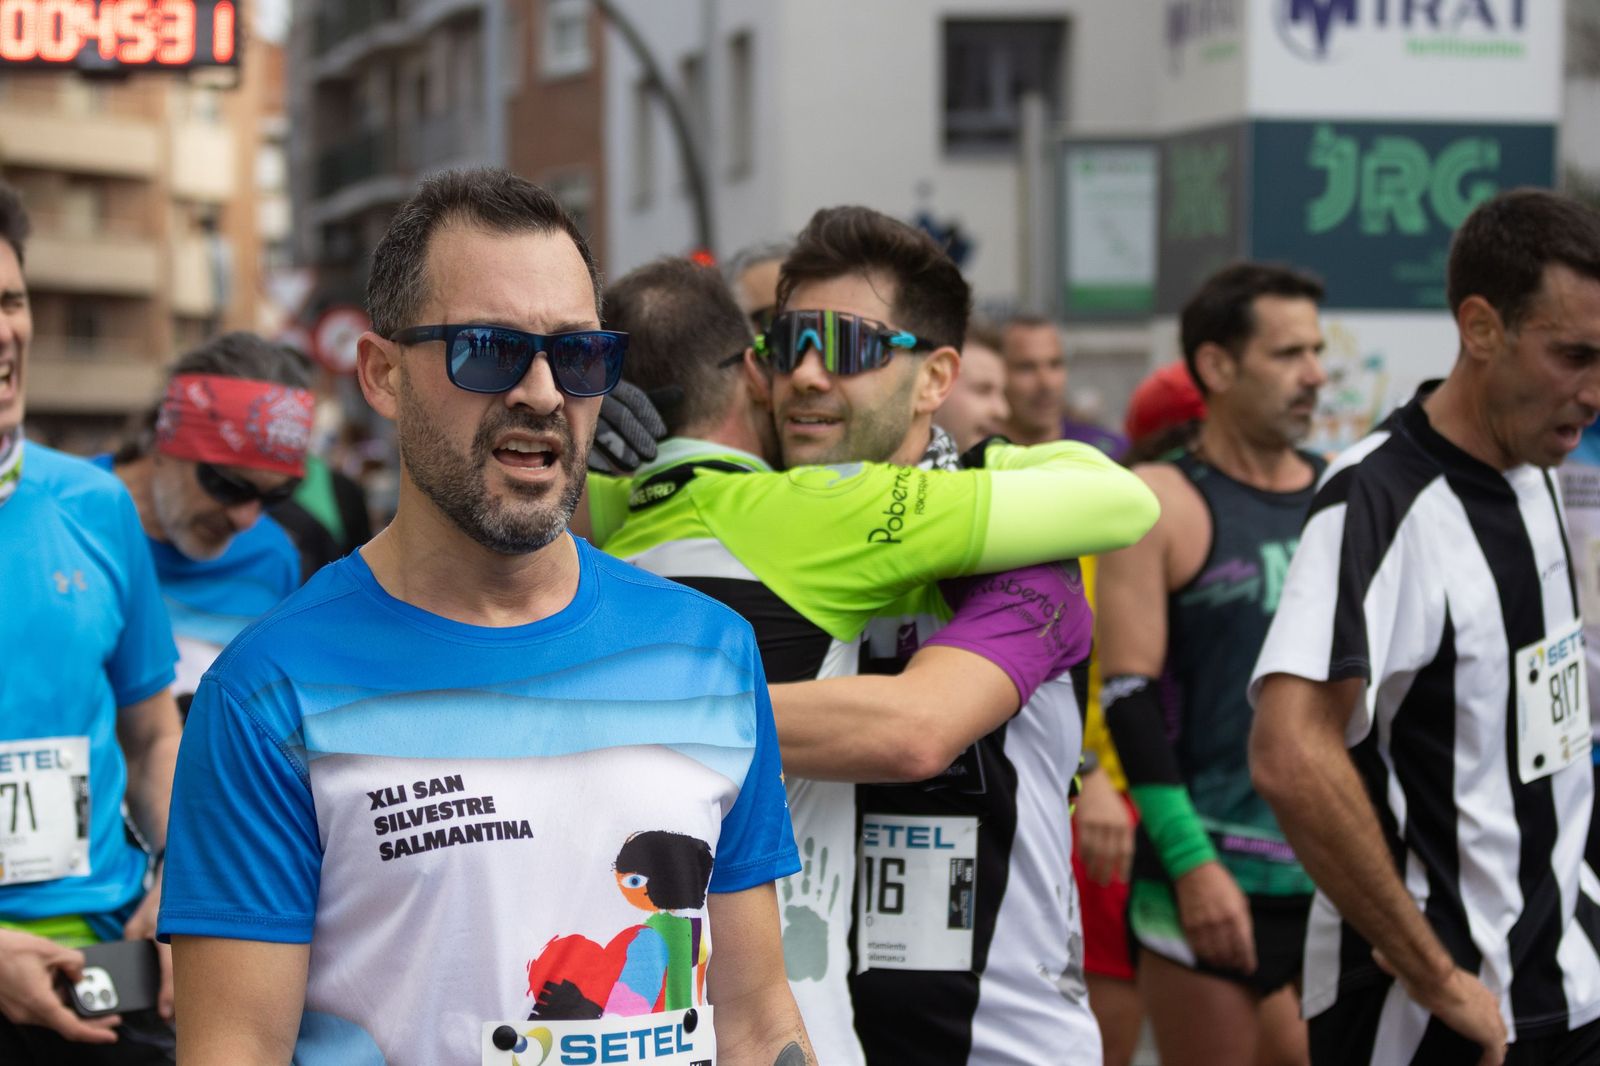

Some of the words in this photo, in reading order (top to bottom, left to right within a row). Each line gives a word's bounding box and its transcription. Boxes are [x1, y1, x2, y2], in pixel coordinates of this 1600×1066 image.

[1307, 124, 1501, 235] JRG
[1549, 661, 1580, 725] 817
[367, 785, 408, 811] XLI
[412, 774, 465, 800] SAN
[374, 796, 496, 836] SILVESTRE
[379, 820, 534, 861] SALMANTINA
[560, 1023, 694, 1066] SETEL
